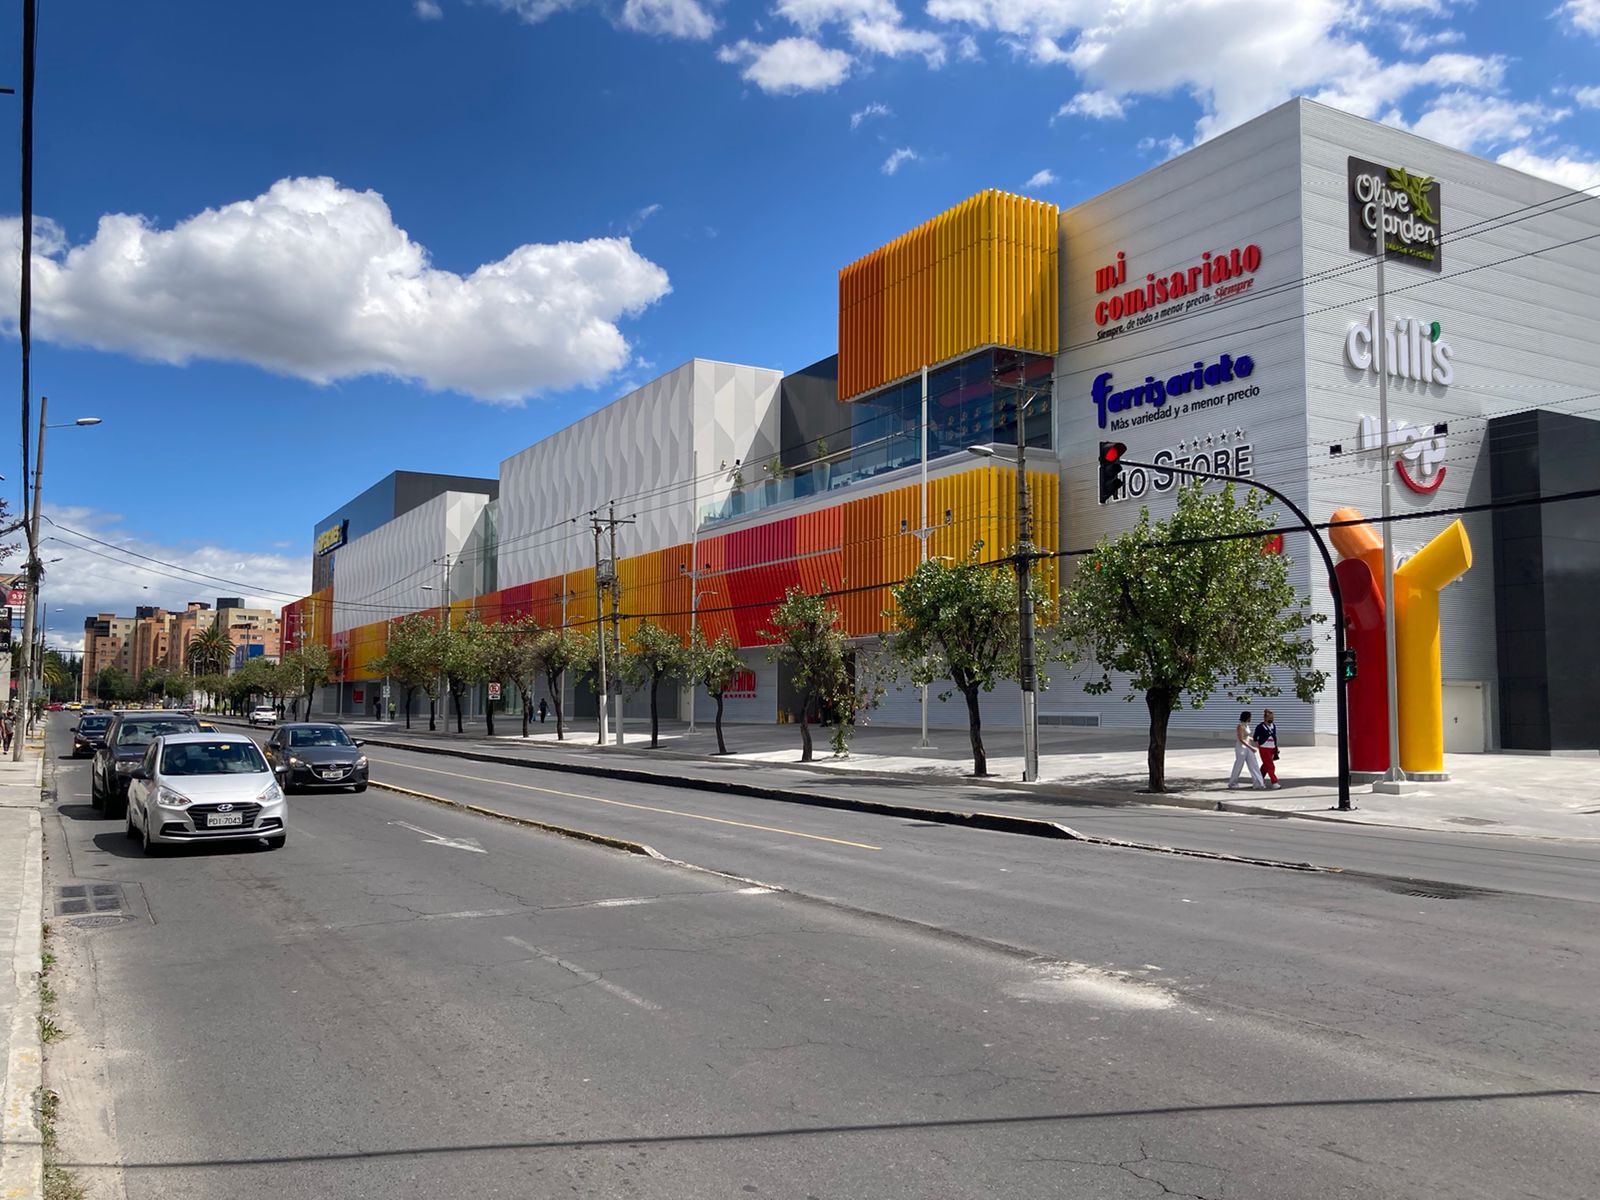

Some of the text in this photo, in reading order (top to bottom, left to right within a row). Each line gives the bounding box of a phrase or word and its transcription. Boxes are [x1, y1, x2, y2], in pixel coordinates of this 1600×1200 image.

[1354, 174, 1409, 213] Olive
[1361, 202, 1440, 246] Garden
[1095, 250, 1126, 293] mi
[1095, 244, 1262, 327] comisariato
[1136, 312, 1153, 327] todo
[1160, 302, 1184, 318] menor
[1111, 385, 1260, 432] Más variedad y a menor precio
[1153, 444, 1254, 492] STORE
